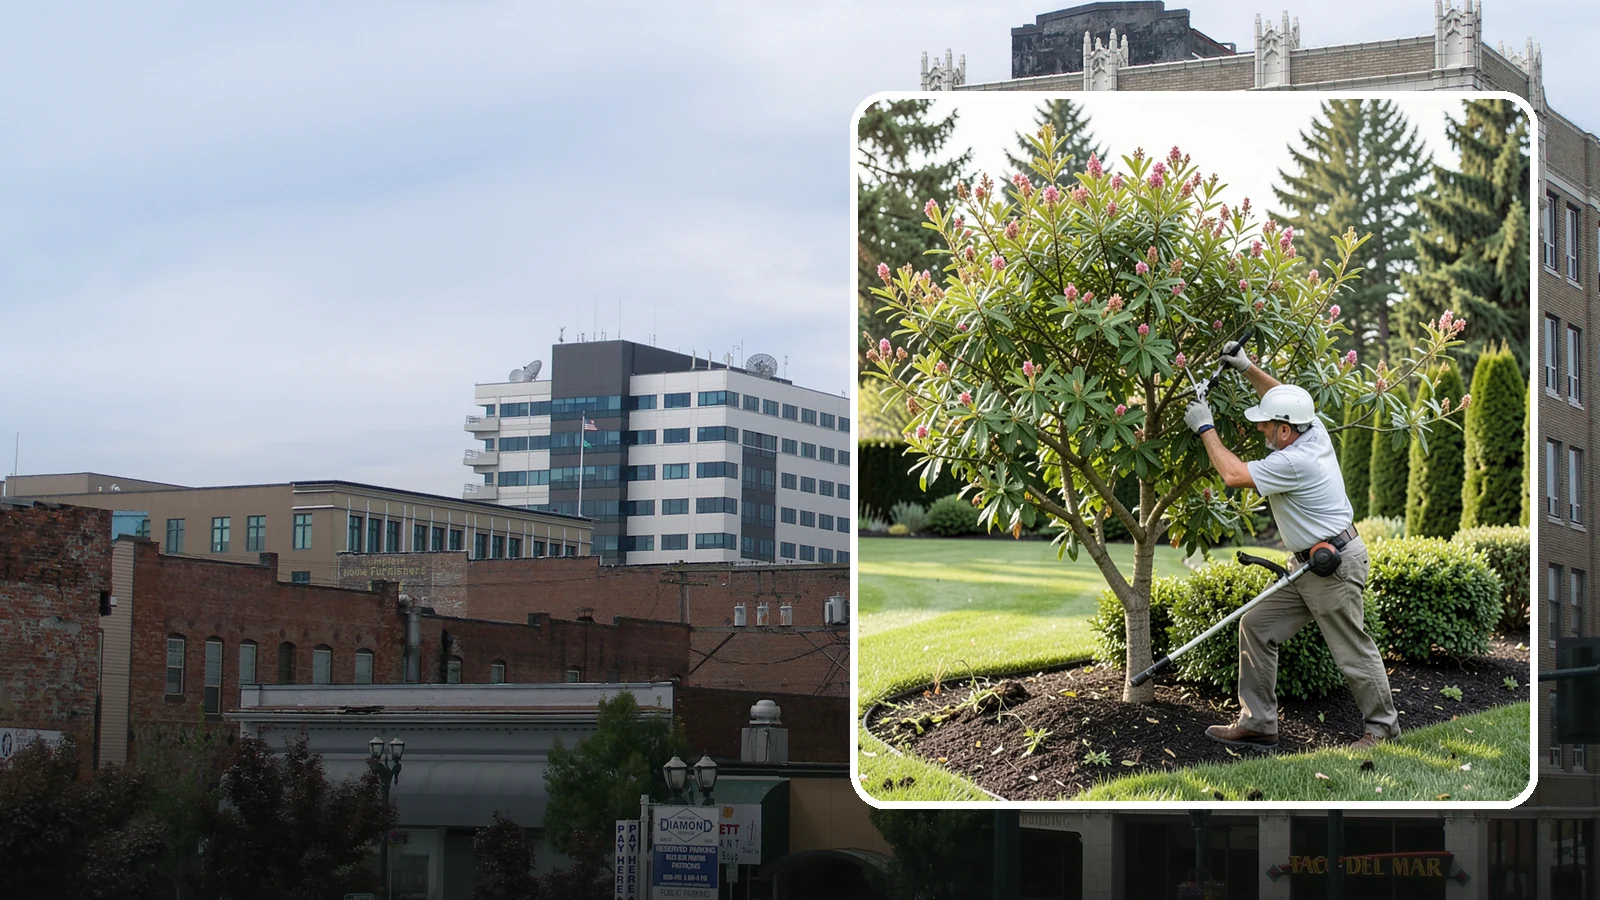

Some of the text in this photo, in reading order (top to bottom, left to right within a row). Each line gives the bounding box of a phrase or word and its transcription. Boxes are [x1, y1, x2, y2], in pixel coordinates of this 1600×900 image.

[370, 566, 427, 577] Furnishers
[660, 818, 713, 833] DIAMOND
[1022, 815, 1069, 827] BUILDING
[617, 825, 625, 852] PAY
[628, 824, 637, 852] PAY
[721, 851, 739, 862] Soup
[616, 856, 625, 893] HERE
[627, 856, 636, 893] HERE
[1289, 855, 1442, 877] TAC DEL MAR
[660, 888, 710, 898] PUBLIC PARKING
